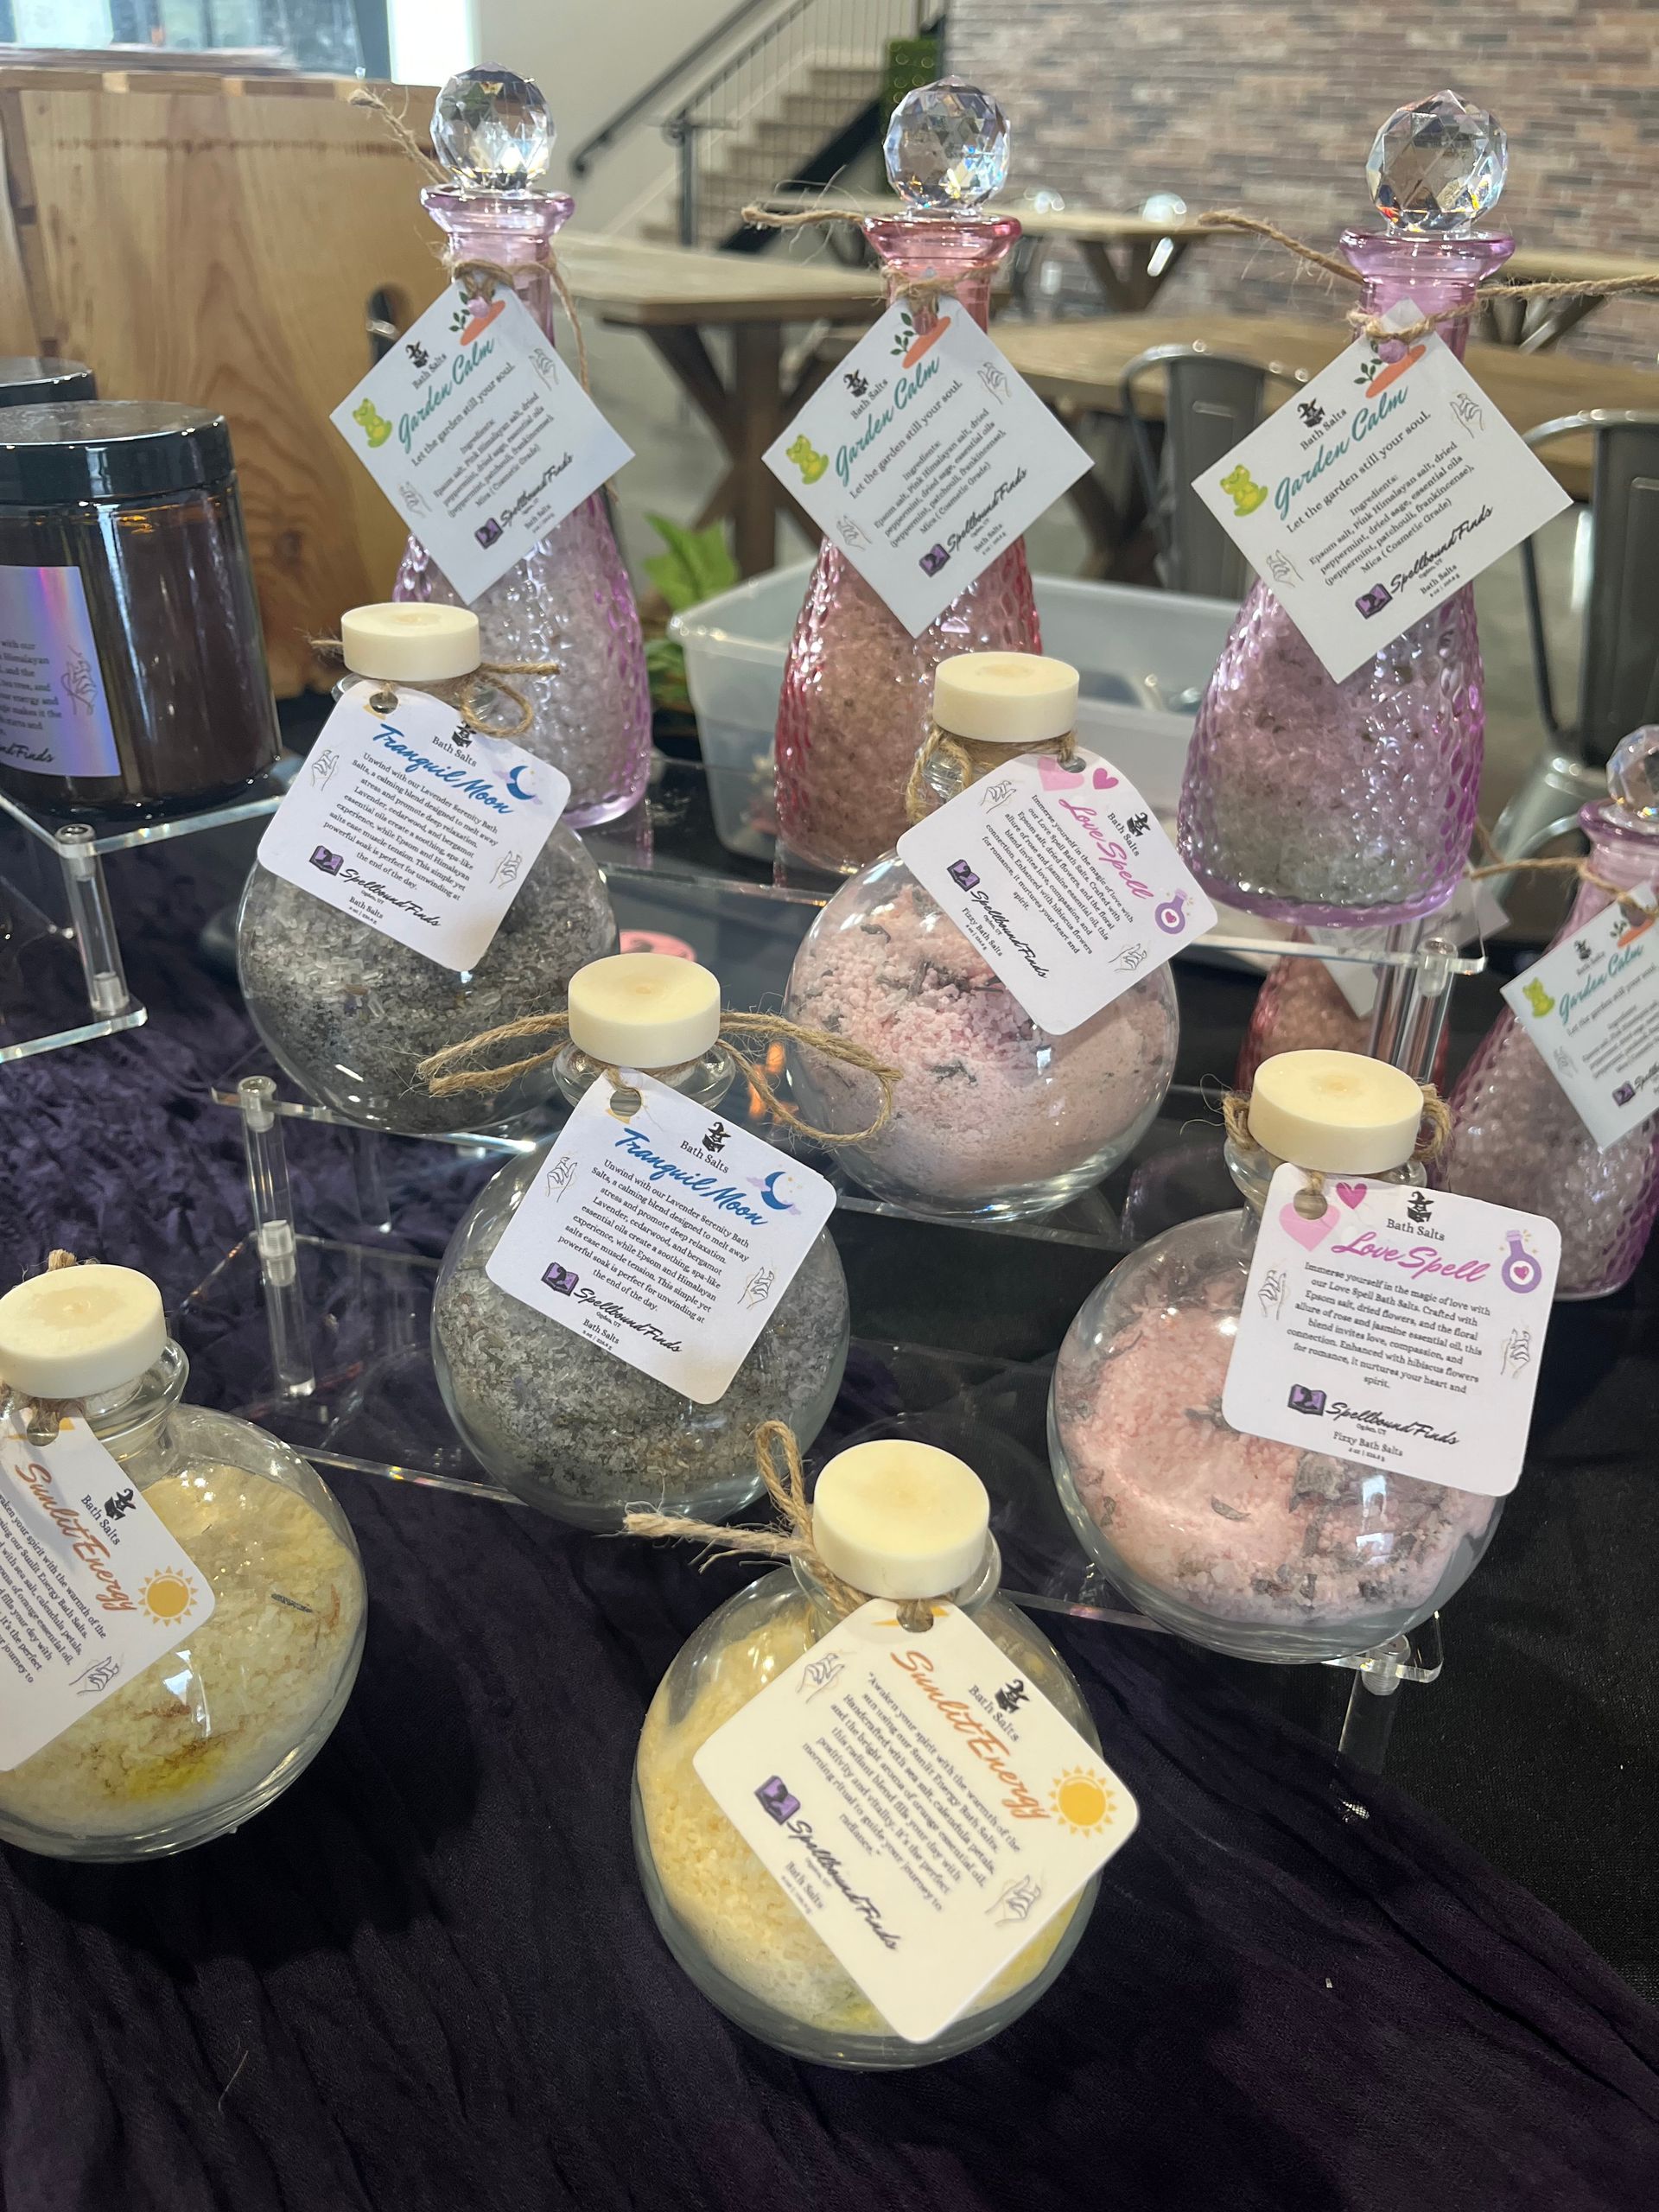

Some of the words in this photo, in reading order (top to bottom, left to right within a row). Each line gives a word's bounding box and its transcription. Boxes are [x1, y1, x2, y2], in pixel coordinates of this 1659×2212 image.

[835, 405, 894, 487] Garden
[893, 356, 939, 410] Calm
[1274, 436, 1351, 521] Garden
[1351, 386, 1408, 442] Calm
[1299, 429, 1324, 450] Bath
[1322, 408, 1347, 431] Salts
[1285, 516, 1306, 533] Let
[1303, 502, 1322, 518] the
[1322, 472, 1359, 506] garden
[1358, 452, 1380, 474] still
[1378, 431, 1403, 459] your
[1308, 541, 1338, 565] Epsom
[1352, 512, 1373, 530] Pink
[1371, 475, 1417, 514] Himalayan
[1433, 440, 1458, 463] dried
[372, 722, 467, 782] Tranquil
[450, 778, 521, 814] Moon
[431, 735, 454, 753] Bath
[454, 748, 477, 767] Salts
[1030, 793, 1055, 823] Immerse
[1051, 822, 1078, 849] yourself
[1079, 854, 1090, 867] the
[1088, 865, 1106, 886] magic
[1109, 891, 1122, 907] love
[1120, 906, 1134, 923] with
[1106, 811, 1125, 834] Bath
[1122, 832, 1140, 856] Salts
[961, 906, 978, 925] Fizzy
[975, 923, 990, 941] Bath
[987, 939, 1002, 957] Salts
[613, 1127, 718, 1191] Tranquil
[698, 1186, 775, 1225] Moon
[679, 1140, 704, 1160] Bath
[703, 1153, 728, 1173] Salts
[603, 1158, 634, 1181] Unwind
[633, 1177, 652, 1192] with
[651, 1187, 666, 1198] our
[664, 1193, 701, 1219] Lavender
[699, 1214, 732, 1237] Serenity
[730, 1232, 749, 1248] Bath
[617, 1182, 648, 1205] calming
[646, 1197, 671, 1216] blend
[668, 1211, 703, 1235] designed
[709, 1236, 729, 1250] melt
[728, 1247, 749, 1262] away
[1385, 1217, 1414, 1234] Bath
[1415, 1224, 1445, 1241] Salts
[581, 1205, 615, 1227] essential
[613, 1224, 628, 1236] oils
[627, 1231, 652, 1249] create
[690, 1268, 721, 1289] spa-like
[592, 1268, 606, 1281] the
[605, 1277, 622, 1289] end
[628, 1289, 643, 1301] the
[671, 1243, 688, 1255] and
[685, 1249, 722, 1275] bergamot
[1332, 1430, 1357, 1446] Fizzy
[1357, 1437, 1380, 1451] Bath
[1380, 1443, 1403, 1457] Salts
[79, 1493, 102, 1521] Bath
[99, 1517, 120, 1546] Salts
[10, 1516, 29, 1536] your
[25, 1535, 45, 1557] spirit
[41, 1554, 58, 1575] with
[54, 1572, 67, 1588] the
[65, 1586, 90, 1618] warmth
[93, 1624, 106, 1638] the
[10, 1535, 23, 1550] our
[19, 1548, 41, 1574] Sunlit
[36, 1571, 60, 1600] Energy
[56, 1597, 73, 1619] Bath
[968, 1684, 994, 1714] Bath
[991, 1711, 1019, 1742] Salts
